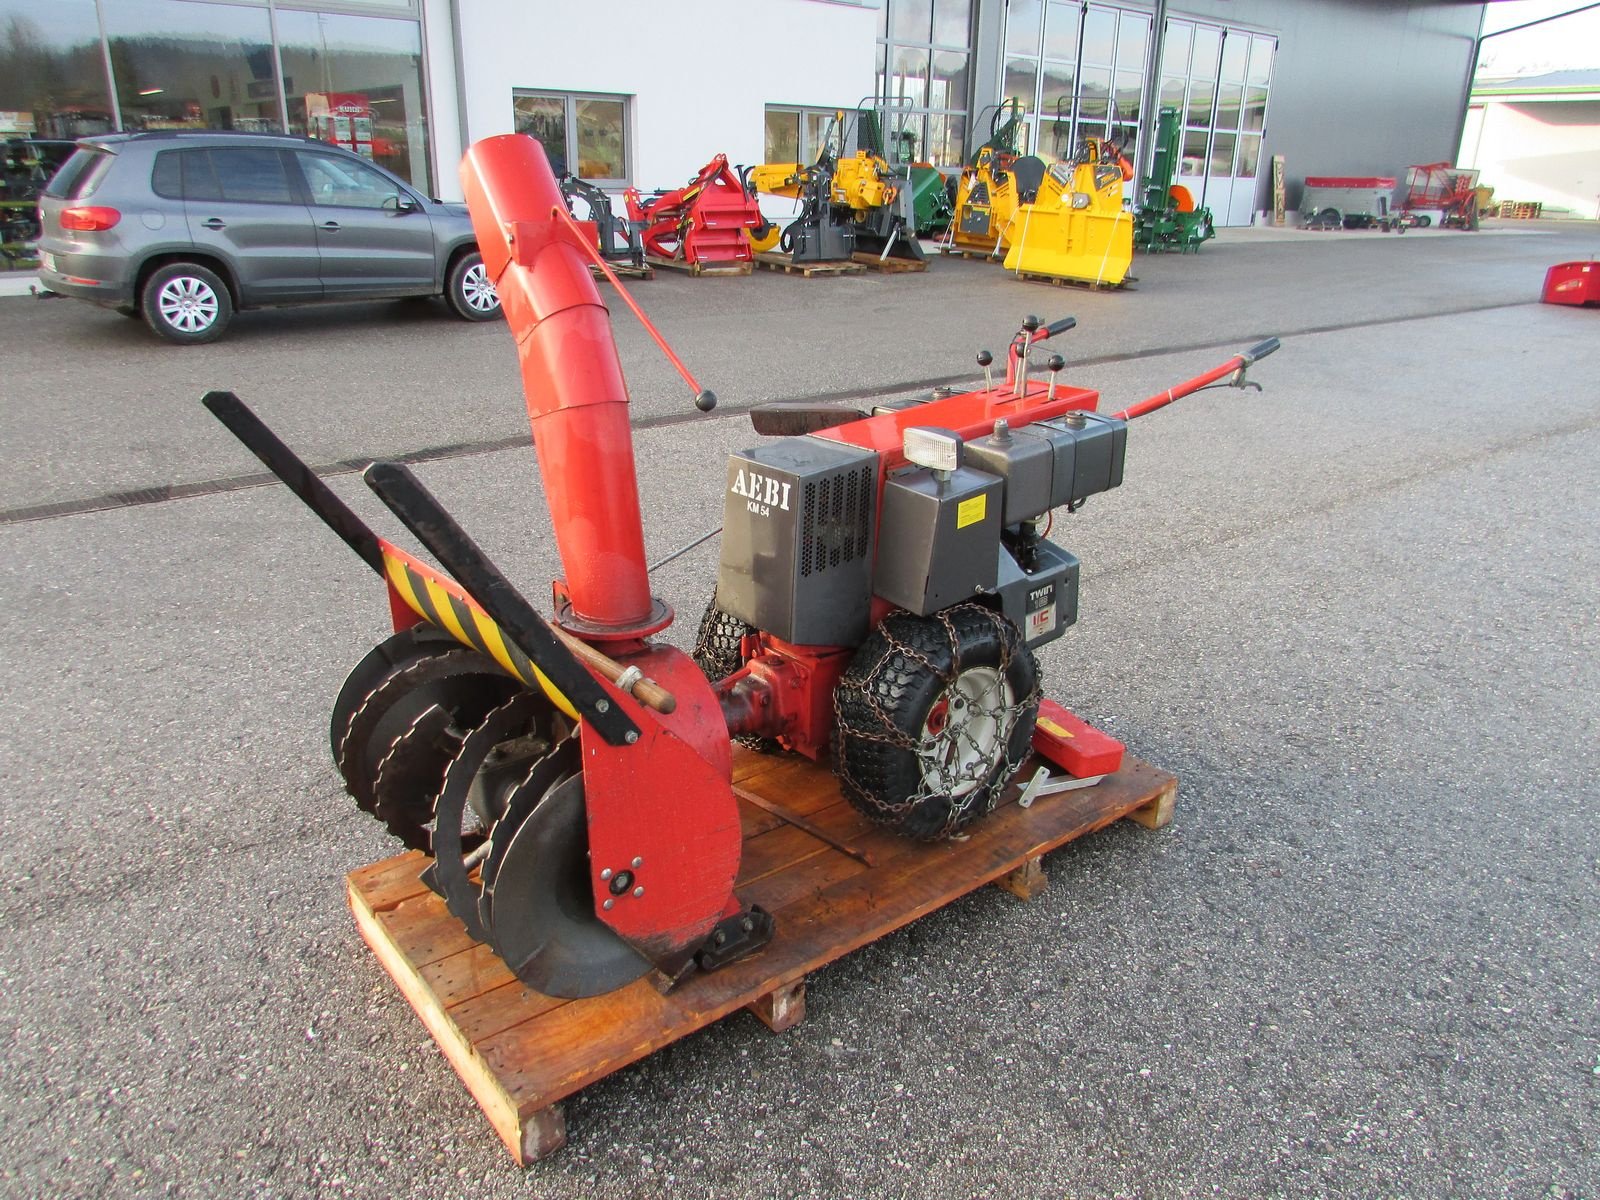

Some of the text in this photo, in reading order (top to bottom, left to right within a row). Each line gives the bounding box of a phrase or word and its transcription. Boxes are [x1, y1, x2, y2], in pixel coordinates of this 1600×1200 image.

[731, 469, 791, 511] AEBI
[747, 501, 770, 518] KM 54
